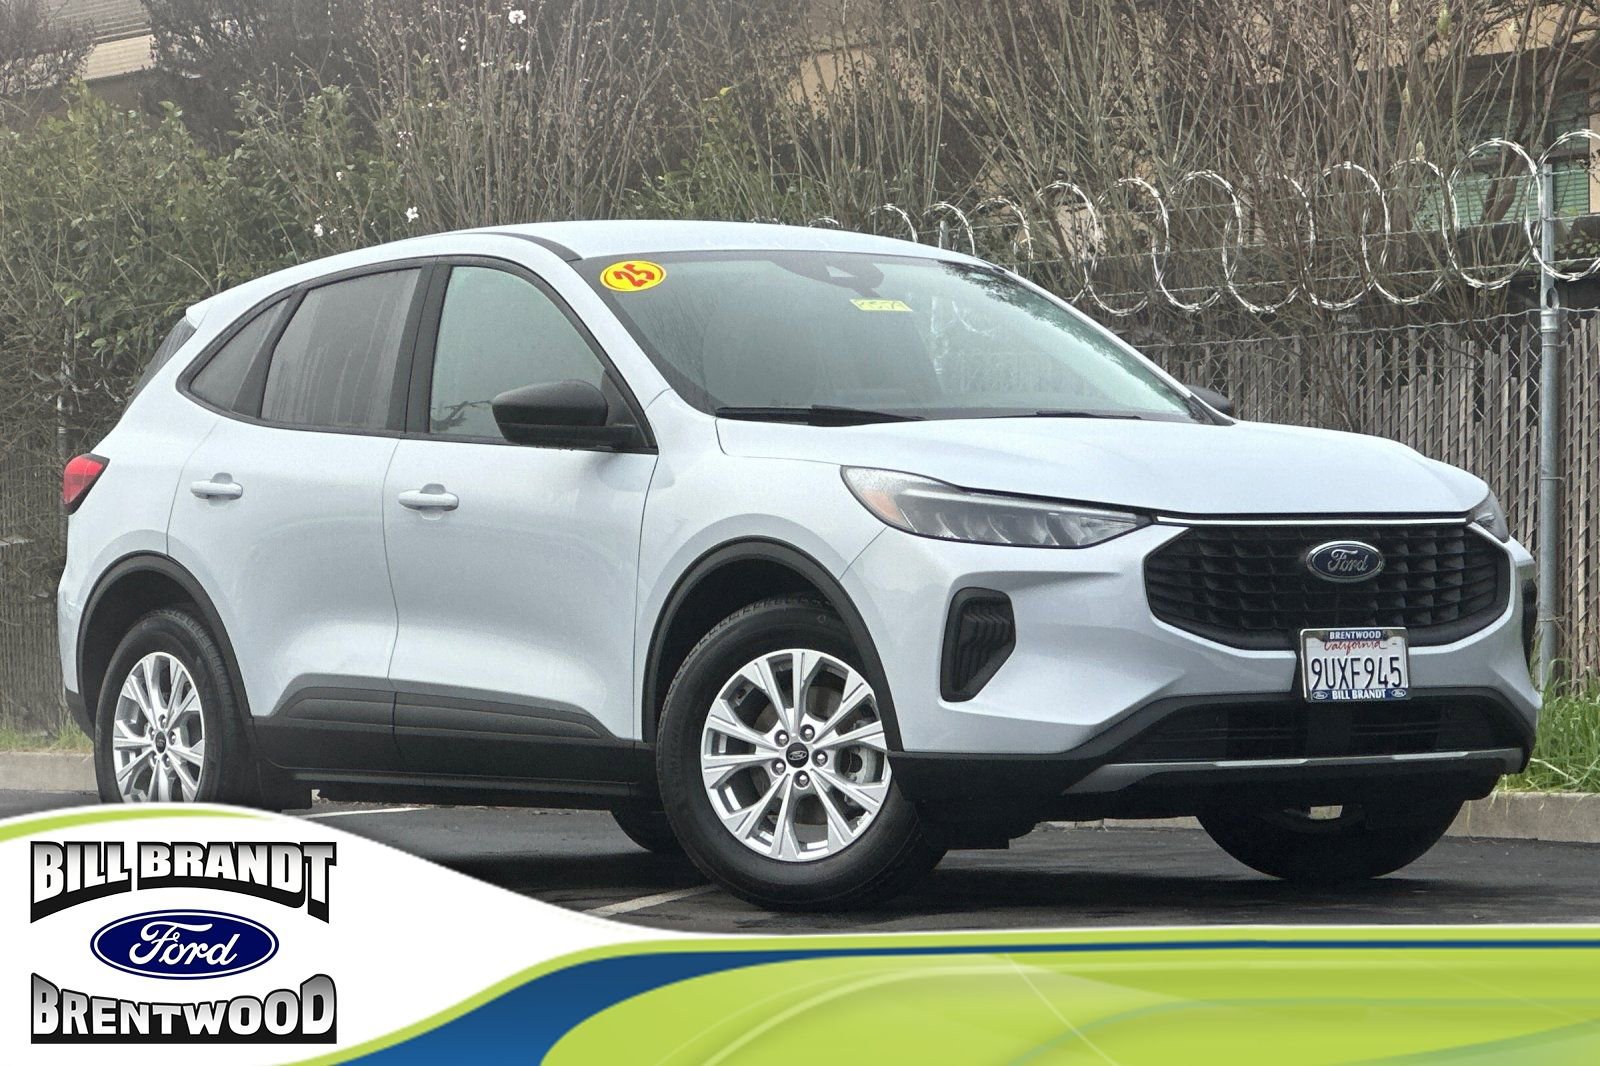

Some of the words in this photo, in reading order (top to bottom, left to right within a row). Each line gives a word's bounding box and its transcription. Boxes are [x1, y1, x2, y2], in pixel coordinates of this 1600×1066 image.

[613, 264, 655, 287] 25
[1327, 549, 1368, 572] Ford
[1329, 630, 1381, 640] BRENTWOOD
[1311, 656, 1402, 690] 9UXF945
[1332, 690, 1350, 700] BILL
[1352, 689, 1386, 699] BRANDT
